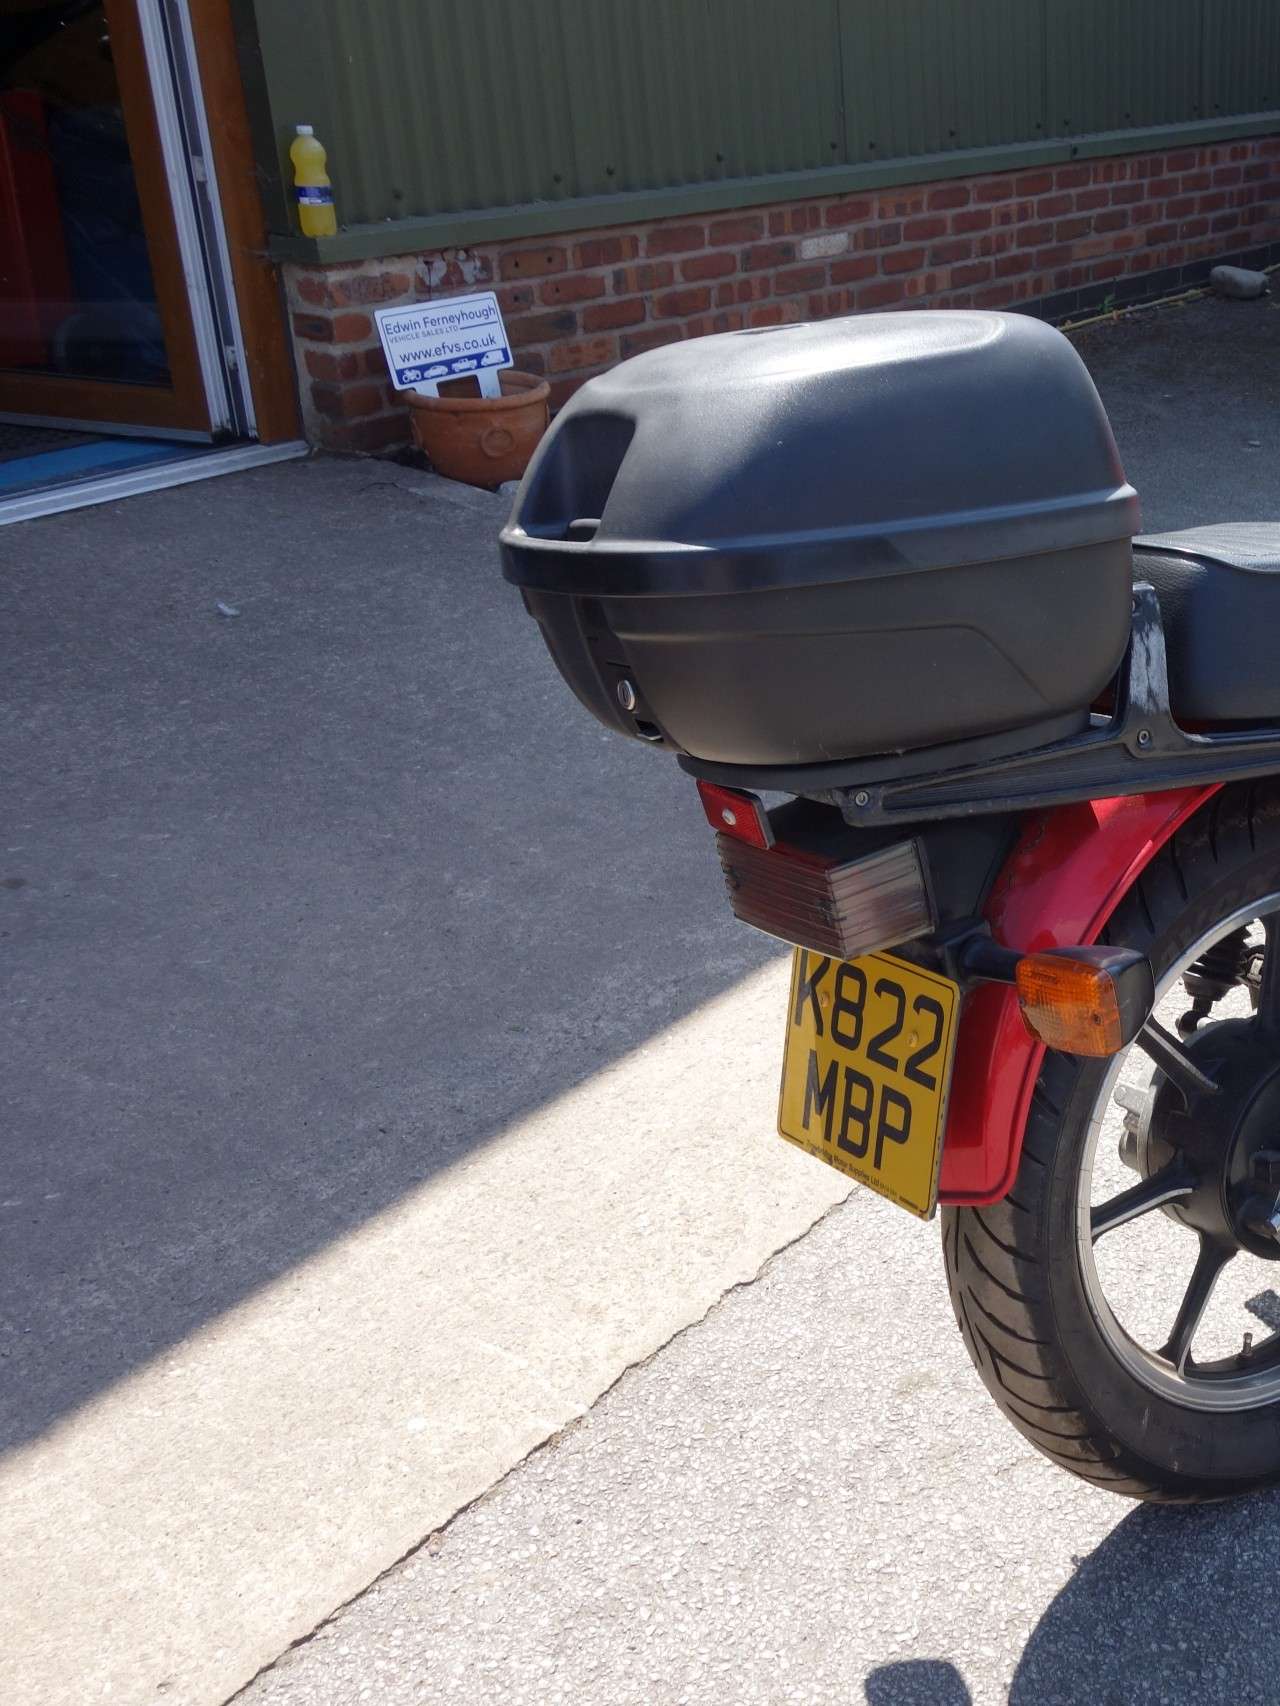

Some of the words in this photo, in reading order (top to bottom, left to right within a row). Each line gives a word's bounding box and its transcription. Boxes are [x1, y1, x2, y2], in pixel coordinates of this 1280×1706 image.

[385, 320, 421, 335] Edwin
[422, 304, 496, 327] Ferneyhough
[388, 331, 420, 344] VEHICLE
[421, 327, 444, 338] SALES
[445, 324, 459, 334] LTD
[400, 333, 496, 363] www.efvs.co.uk
[795, 949, 944, 1092] K822
[802, 1048, 912, 1170] MBP
